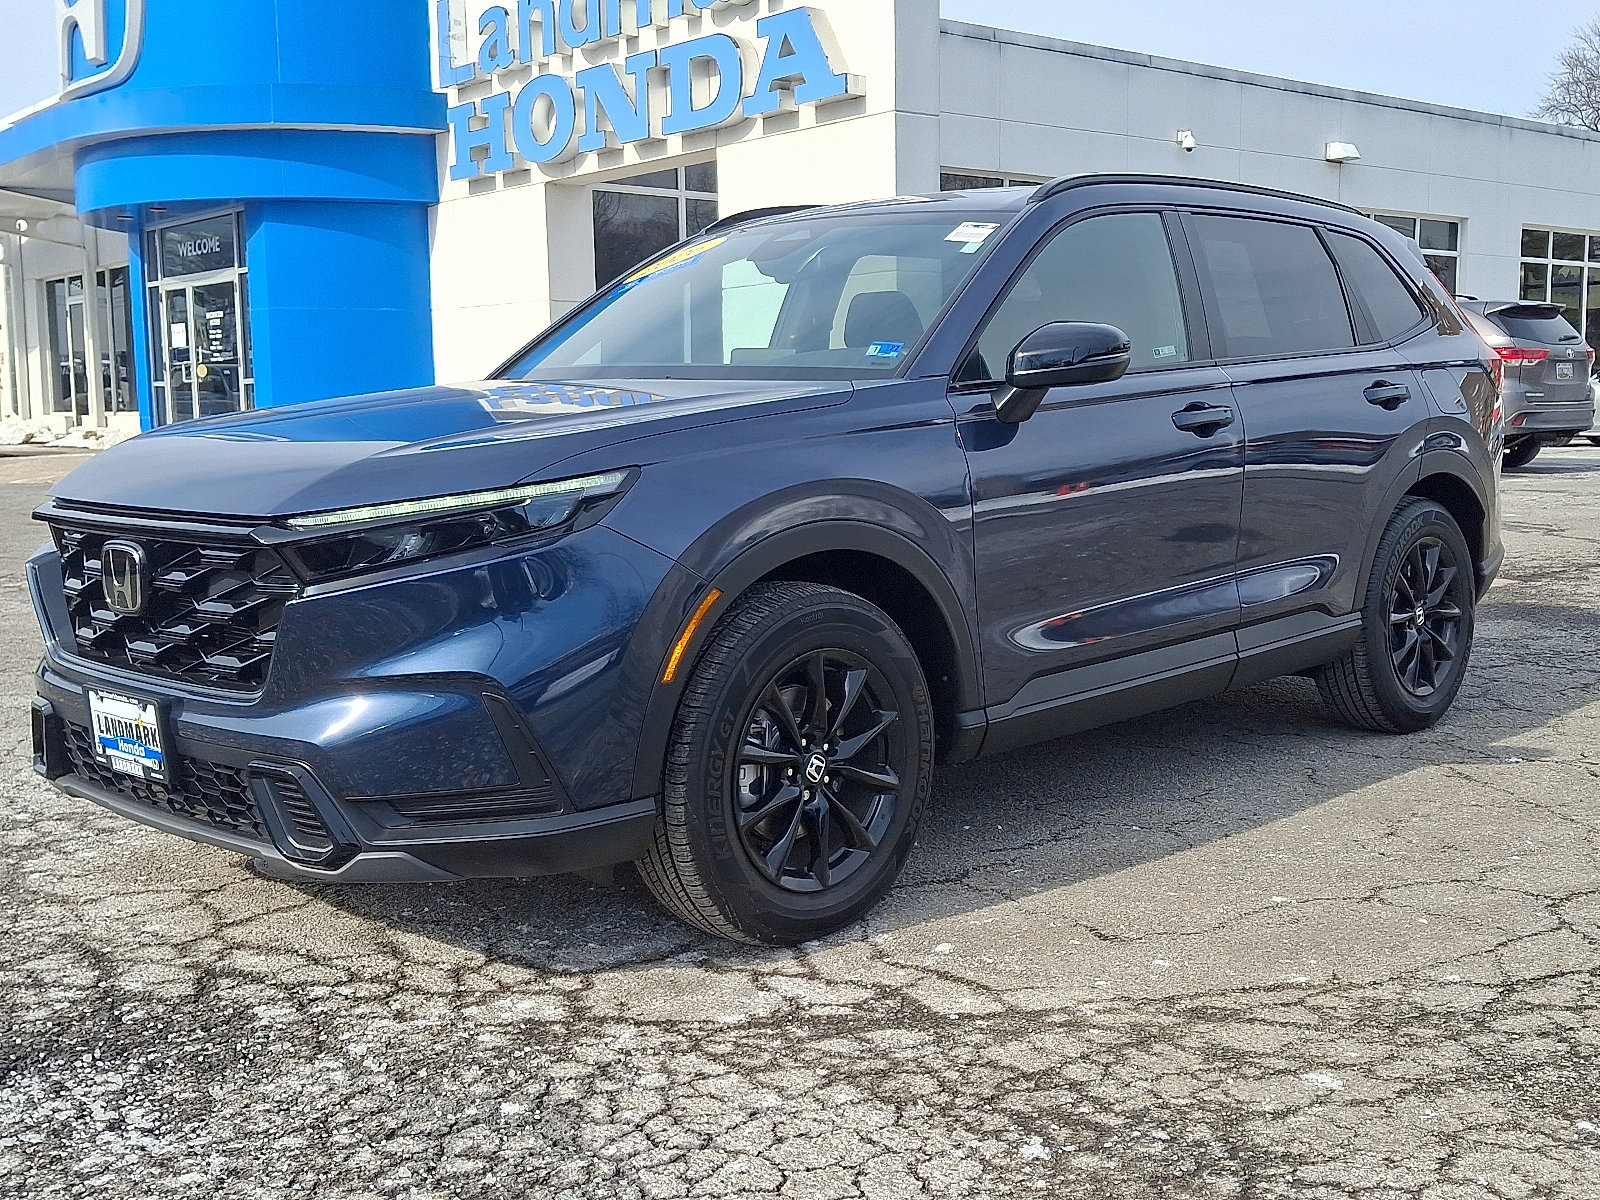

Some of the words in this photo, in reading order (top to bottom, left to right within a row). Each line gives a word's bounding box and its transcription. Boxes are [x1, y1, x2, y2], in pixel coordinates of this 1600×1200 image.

[447, 6, 848, 181] HONDA
[178, 236, 221, 258] WELCOME
[96, 712, 160, 750] LANDMARK
[118, 739, 147, 757] Honda
